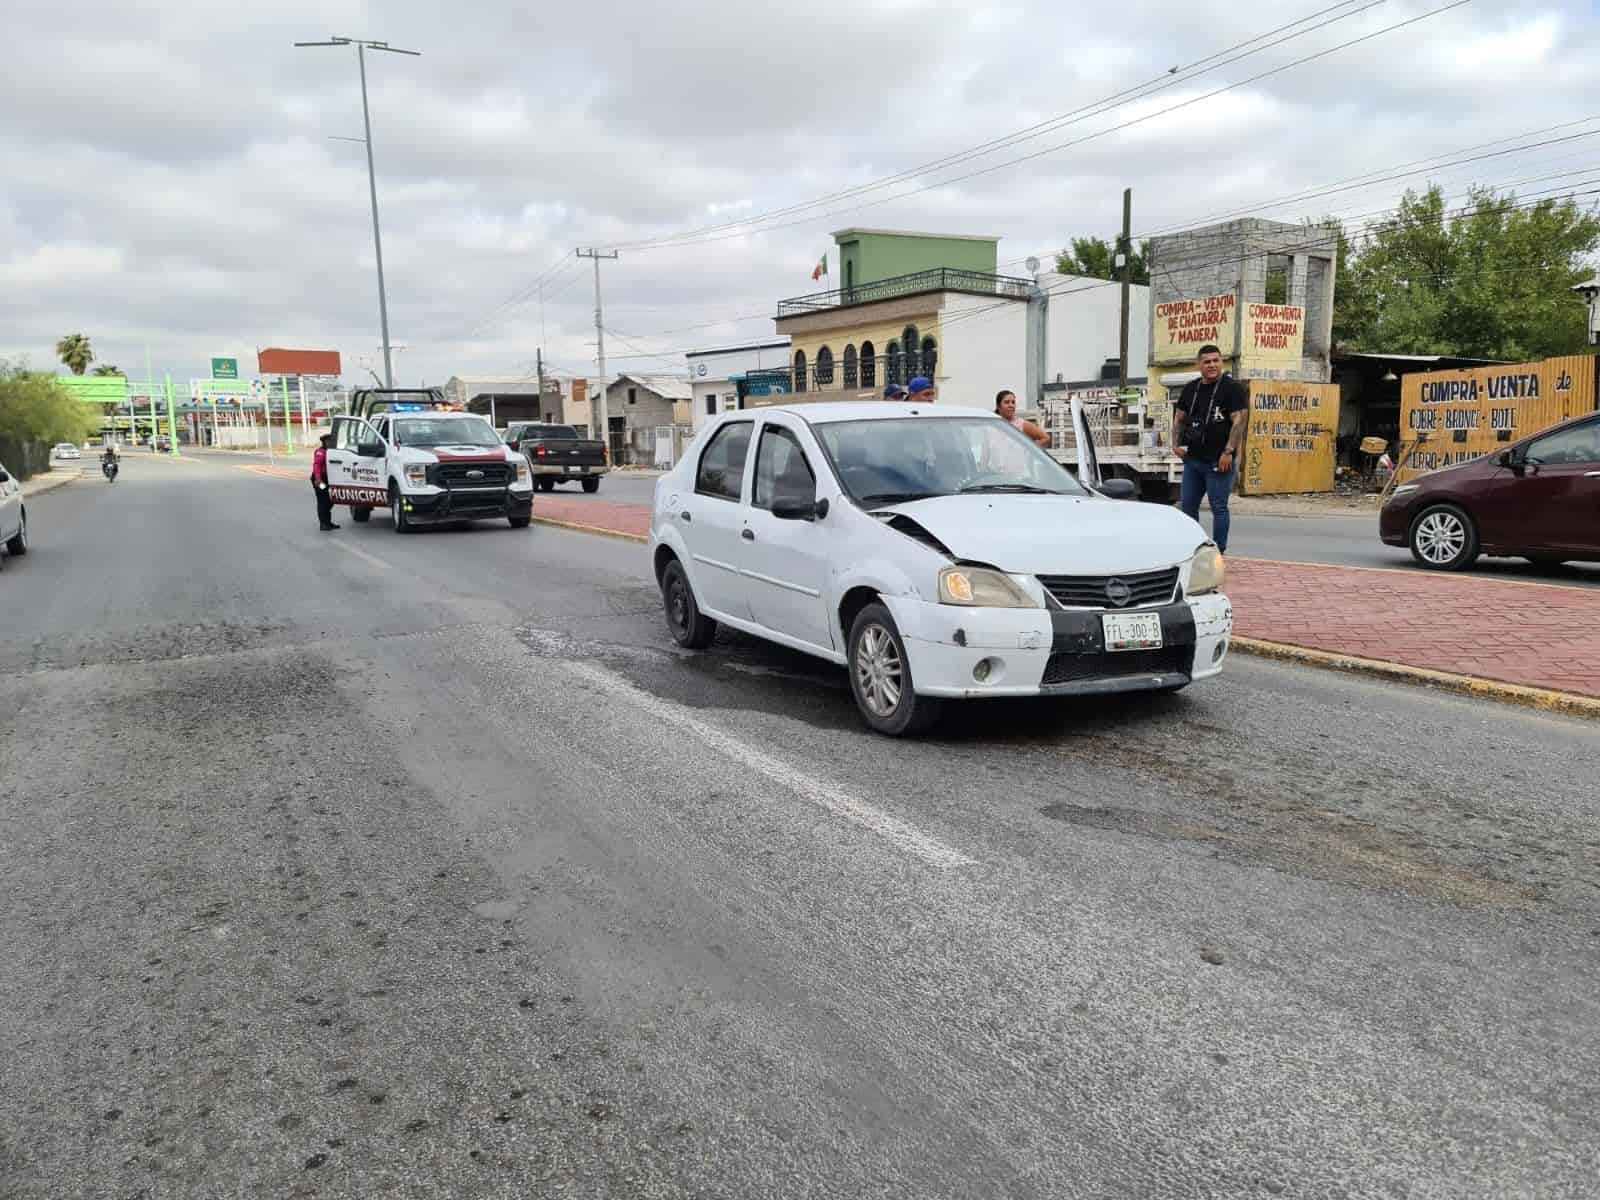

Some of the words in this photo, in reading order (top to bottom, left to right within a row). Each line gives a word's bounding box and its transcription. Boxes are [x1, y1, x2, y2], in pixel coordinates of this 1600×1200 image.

[1168, 317, 1179, 330] DE
[1180, 310, 1228, 328] CHATARRA
[1179, 327, 1218, 344] MADERA
[1255, 322, 1263, 334] DE
[1264, 323, 1297, 336] CHATARRA
[1260, 335, 1288, 349] MADERA
[1446, 409, 1480, 428] BRONCE
[1491, 408, 1517, 428] BOTE
